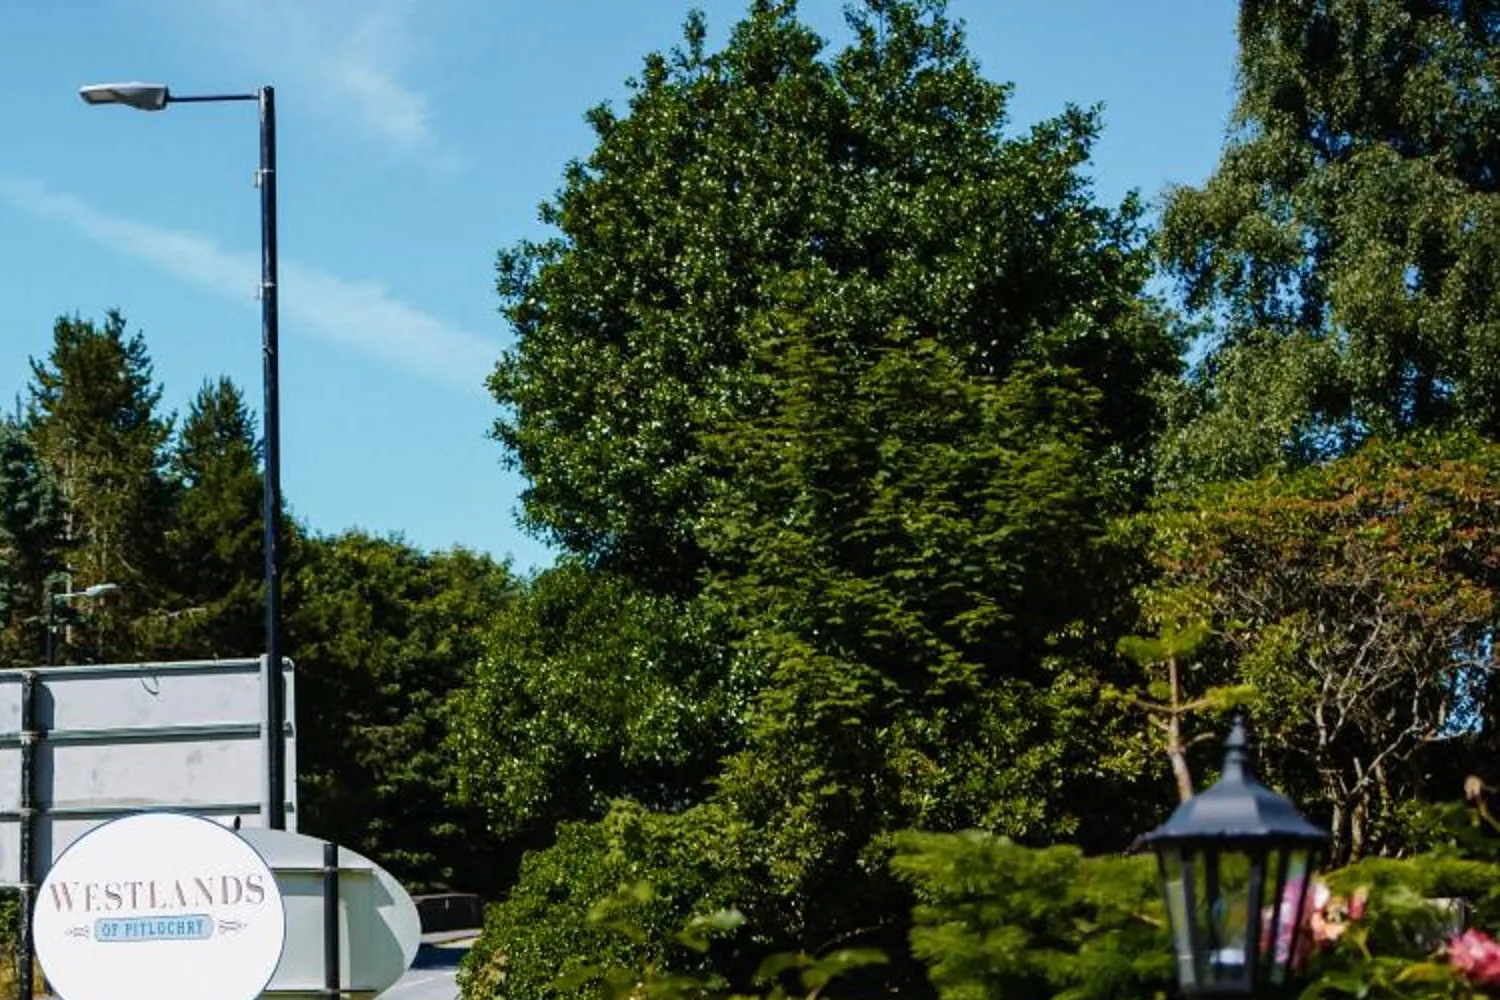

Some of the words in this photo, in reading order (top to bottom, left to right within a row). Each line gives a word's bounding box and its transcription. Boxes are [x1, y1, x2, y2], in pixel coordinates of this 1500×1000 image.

[49, 874, 266, 913] WESTLANDS
[101, 923, 119, 937] OF
[125, 919, 204, 937] PITLOCHRY
